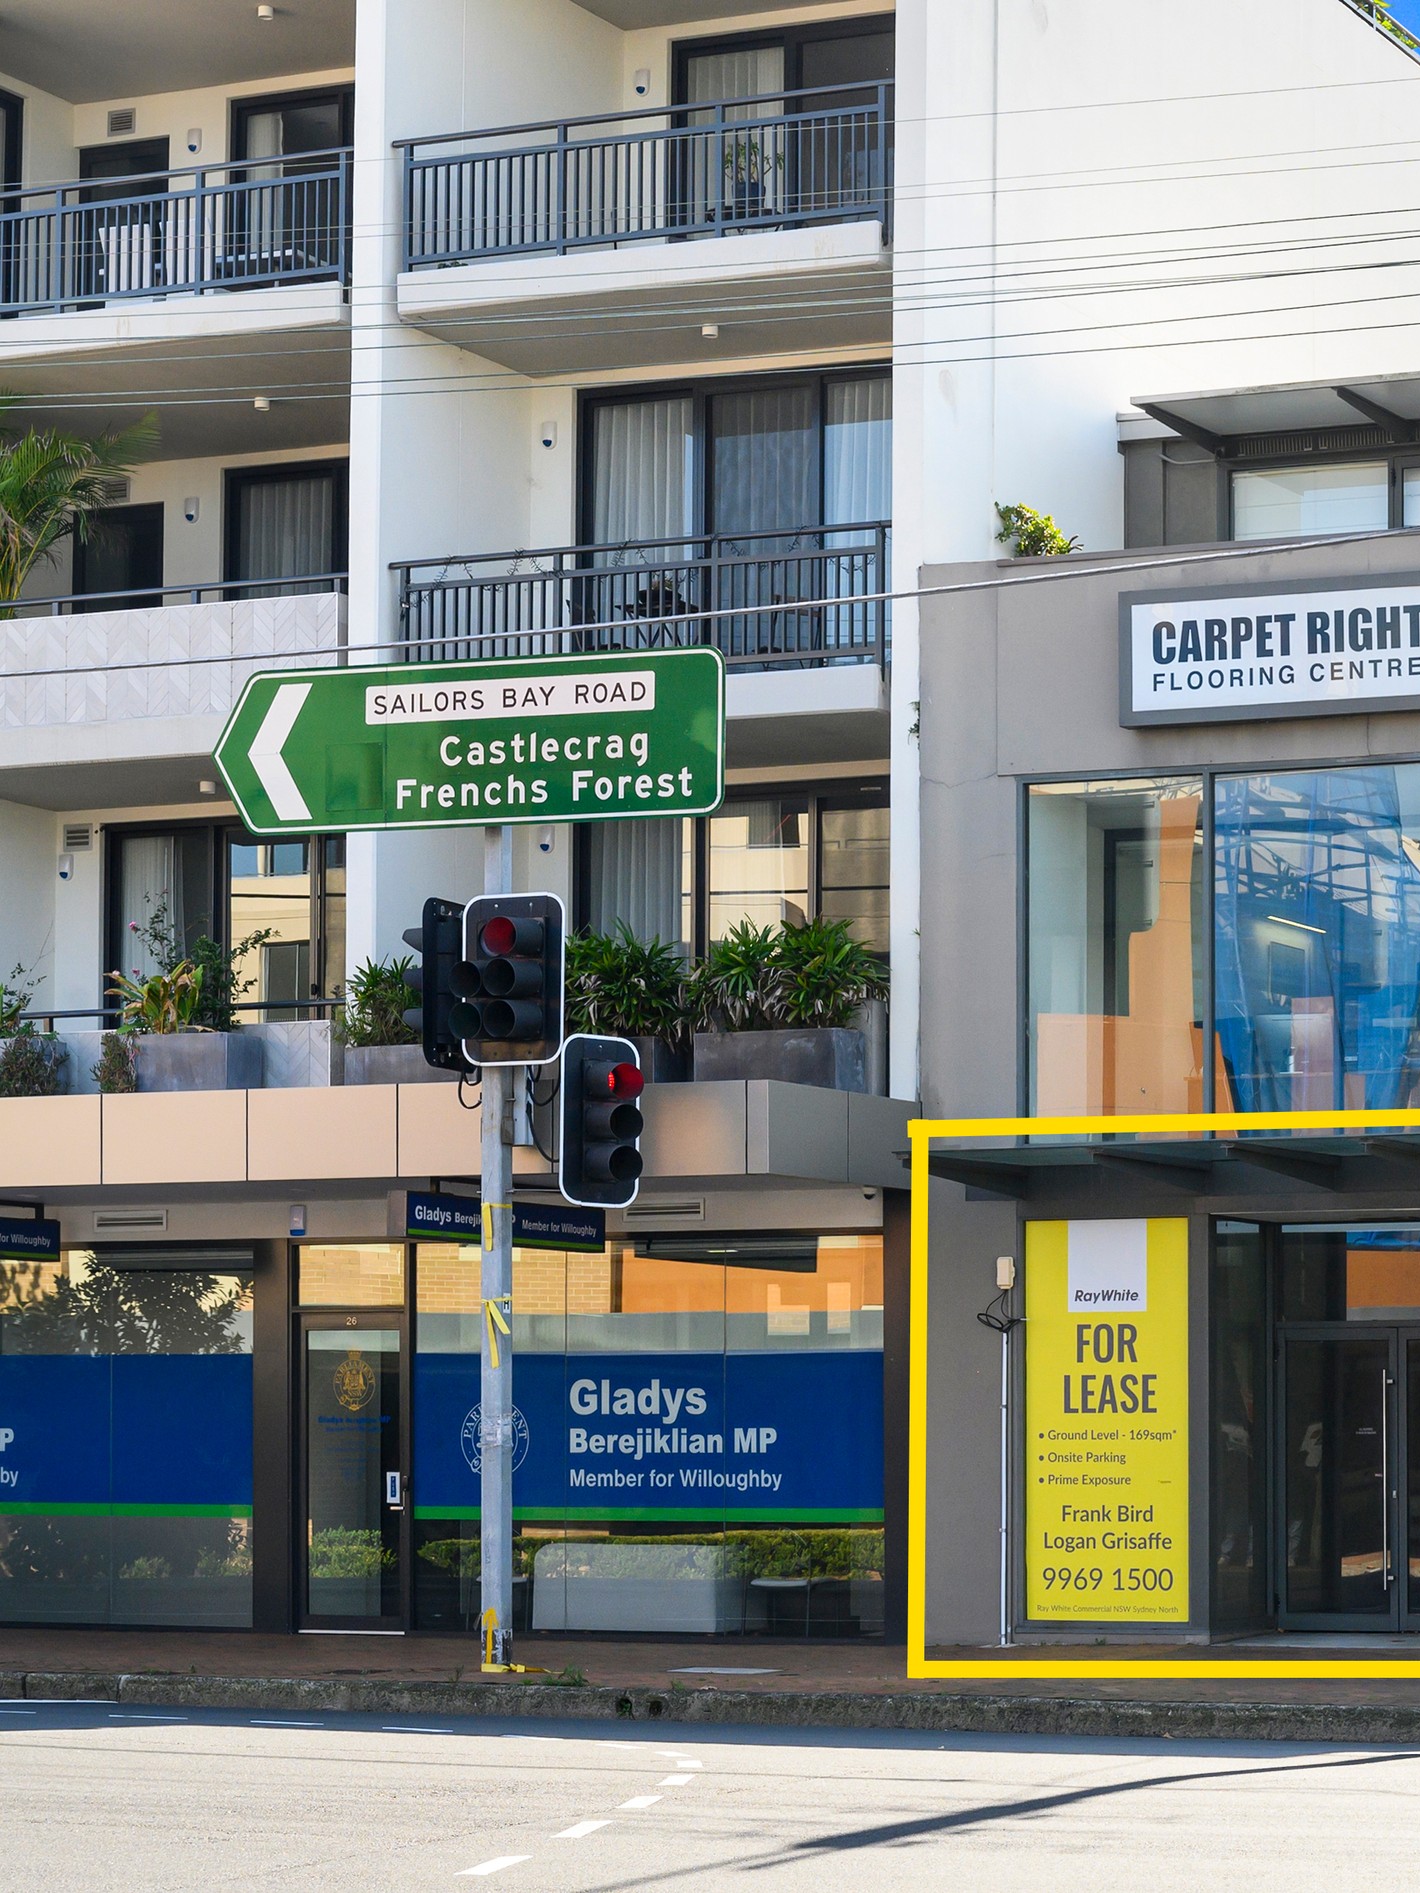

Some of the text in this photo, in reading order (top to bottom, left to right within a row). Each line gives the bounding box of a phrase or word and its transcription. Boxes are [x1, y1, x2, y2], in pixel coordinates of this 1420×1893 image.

[1152, 612, 1296, 665] CARPET
[1152, 665, 1296, 692] FLOORING
[373, 680, 647, 716] SAILORS BAY ROAD
[440, 731, 649, 767] Castlecrag
[396, 766, 694, 810] Frenchs Forest
[415, 1204, 482, 1228] Gladys Berejik
[0, 1233, 51, 1248] or Willoughby
[522, 1219, 597, 1238] Member for Willoughby
[346, 1316, 357, 1326] 26
[1076, 1323, 1138, 1363] FOR
[569, 1378, 707, 1424] Gladys
[1063, 1374, 1158, 1414] LEASE
[569, 1427, 777, 1460] Berejiklian MP
[1047, 1430, 1088, 1440] Ground
[1091, 1430, 1119, 1440] Level
[1047, 1451, 1126, 1465] Onsite Parking
[569, 1468, 782, 1491] Member for Willoughby
[1047, 1474, 1132, 1487] Prime Exposure
[1061, 1505, 1154, 1522] Frank Bird
[1043, 1532, 1173, 1553] Logan Grisaffe
[1042, 1567, 1174, 1591] 9969 1500
[1037, 1604, 1179, 1614] Ray White Commercial NSW Sydney North
